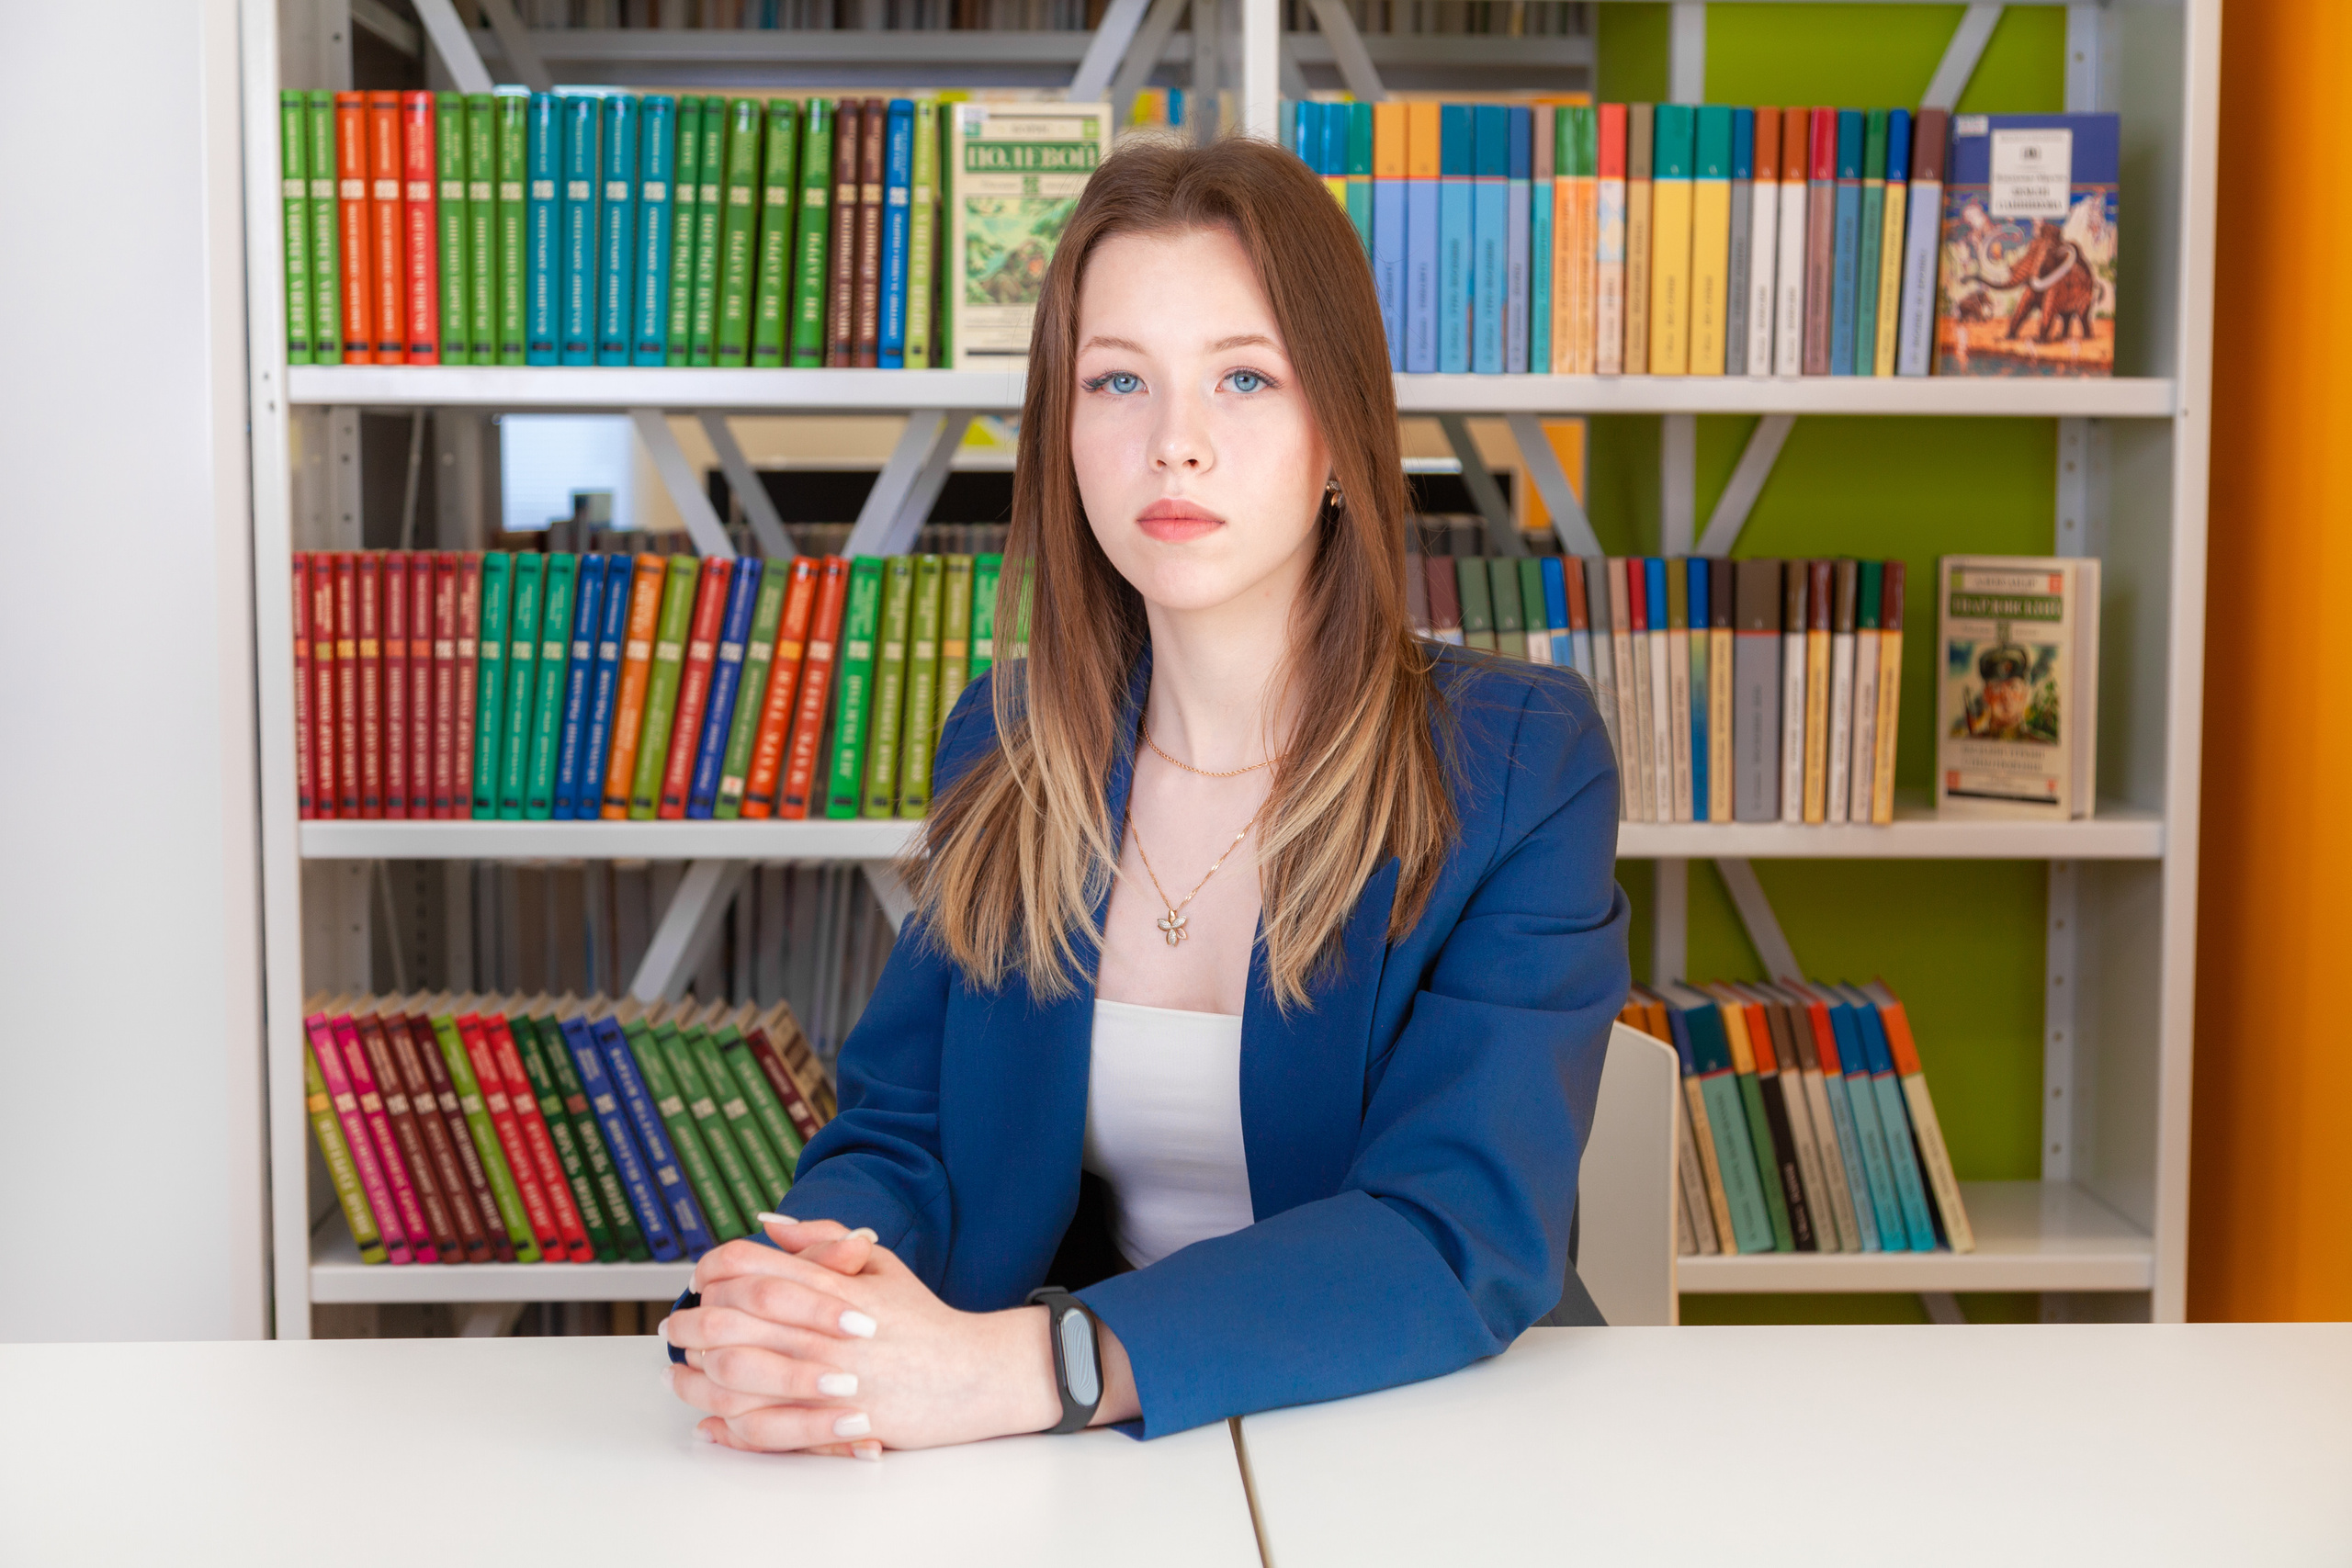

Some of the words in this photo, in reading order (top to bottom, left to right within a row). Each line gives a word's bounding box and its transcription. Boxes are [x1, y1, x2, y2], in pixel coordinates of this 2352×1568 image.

[967, 142, 1098, 168] ПОЛЕВОЙ
[676, 213, 689, 281] КРЫЛОВ
[699, 214, 713, 281] КРЫЛОВ
[729, 231, 745, 288] ЛАРРИ
[765, 231, 782, 289] ЛАРРИ
[805, 231, 821, 291] ЛАРРИ
[290, 279, 306, 336] ЕЛЕНА
[318, 280, 334, 336] ЕЛЕНА
[319, 669, 332, 722] ПУШКИН
[342, 668, 354, 720] ПУШКИН
[364, 667, 376, 719] ПУШКИН
[390, 667, 401, 719] ПУШКИН
[415, 667, 427, 719] ПУШКИН
[438, 668, 450, 720] ПУШКИН
[458, 666, 471, 718] ПУШКИН
[842, 675, 862, 744] ТОЛСТОЙ
[343, 723, 356, 786] АЛЕКСАНДР
[365, 722, 378, 786] АЛЕКСАНДР
[390, 722, 402, 785] АЛЕКСАНДР
[415, 722, 427, 786] АЛЕКСАНДР
[438, 723, 451, 786] АЛЕКСАНДР
[458, 721, 470, 784] АЛЕКСАНДР
[755, 731, 779, 784] МАРК
[768, 670, 790, 721] ТВЕН
[791, 731, 813, 784] МАРК
[803, 670, 823, 721] ТВЕН
[320, 724, 333, 789] АЛЕКСАНДР
[552, 1122, 582, 1174] ЧЕХОВ
[579, 1120, 609, 1172] ЧЕХОВ
